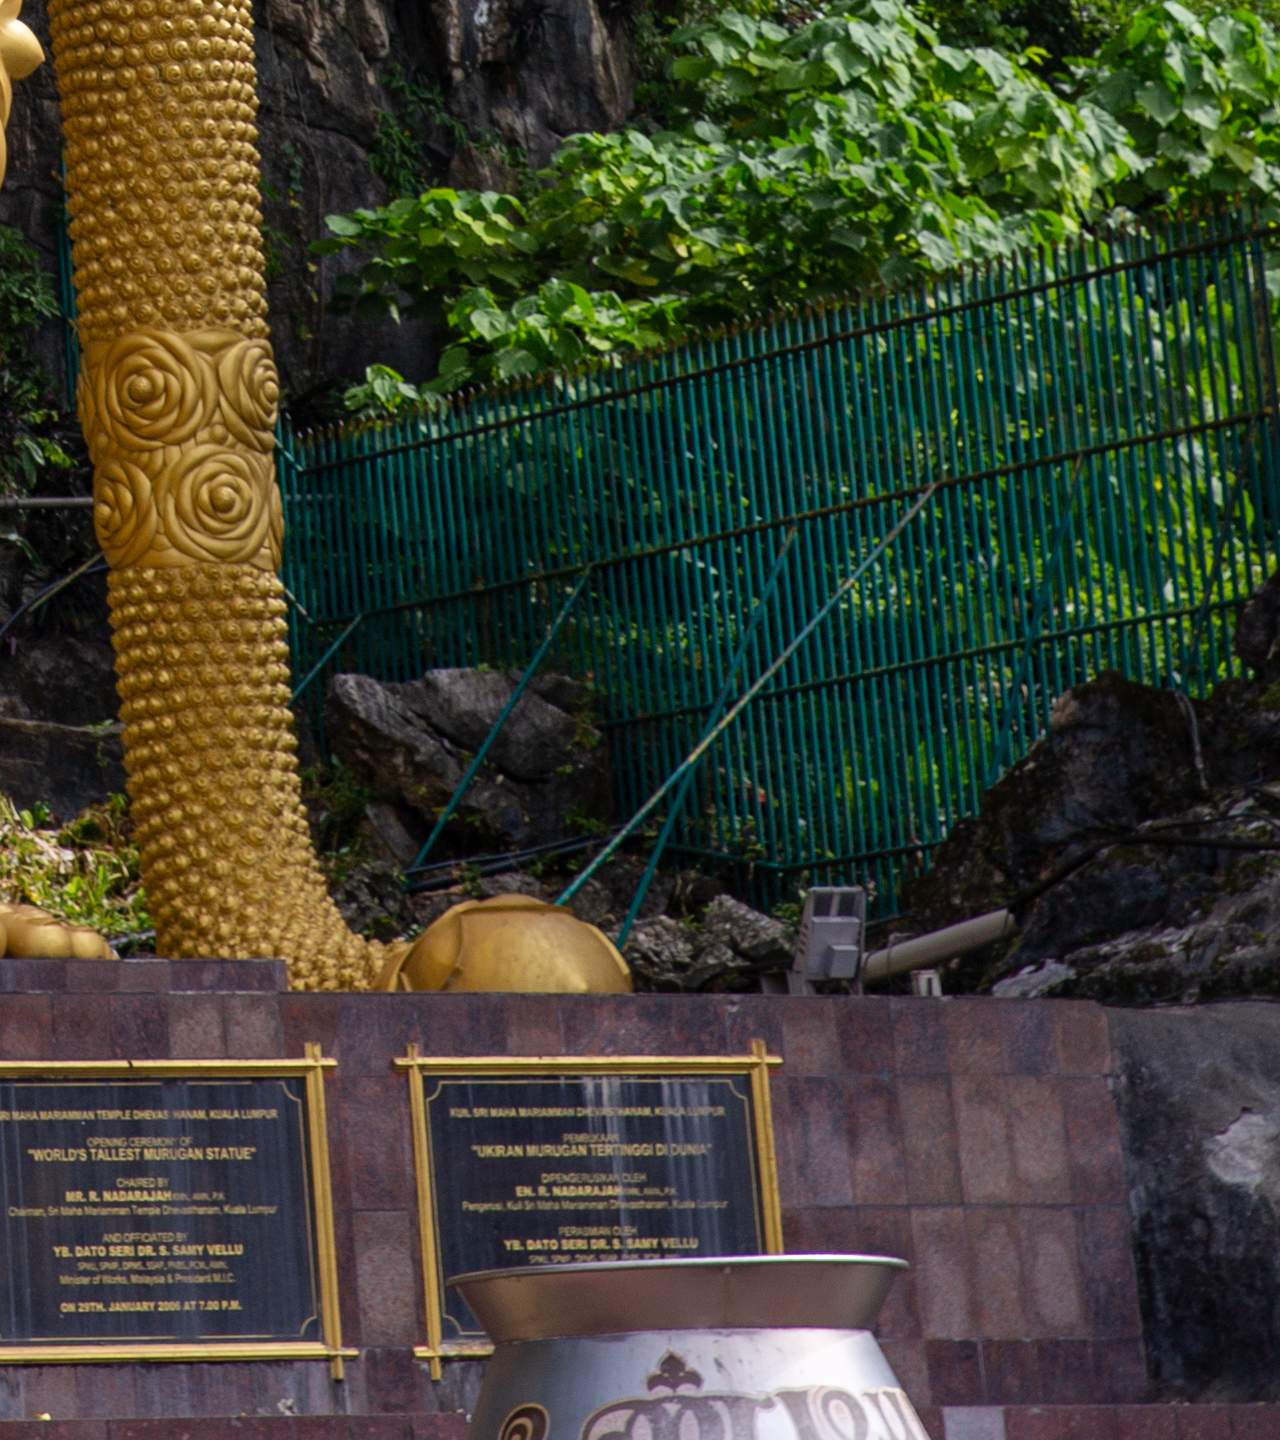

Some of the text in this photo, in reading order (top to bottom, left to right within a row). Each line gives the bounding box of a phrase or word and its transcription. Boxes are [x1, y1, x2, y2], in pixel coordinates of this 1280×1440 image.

[96, 1110, 131, 1120] TEMPLE
[209, 1109, 240, 1119] KUALA
[87, 1137, 127, 1147] OPENING
[90, 1147, 141, 1160] TALLEST
[144, 1147, 203, 1160] MURUGAN
[205, 1146, 256, 1160] STATUE"
[526, 1144, 587, 1157] MURUGAN
[589, 1143, 653, 1157] TERTINGGI
[116, 1177, 169, 1188] CHAIRED BY
[66, 1191, 87, 1202] MR.
[89, 1191, 100, 1202] R.
[102, 1190, 172, 1201] NADARAJAH
[516, 1186, 536, 1196] EN.
[537, 1186, 550, 1196] R.
[131, 1205, 161, 1217] Temple
[223, 1204, 246, 1215] Kuala
[247, 1204, 278, 1216] Lumpur
[103, 1233, 122, 1243] AND
[176, 1232, 188, 1242] BY
[503, 1237, 699, 1251] YB. DATO SERI DR. S. SAMY VELLU
[53, 1244, 244, 1258] YB. DATO SERI DR. S. SAMY VELLU
[60, 1302, 76, 1313] ON
[109, 1301, 155, 1312] JANUARY
[183, 1301, 197, 1311] AT
